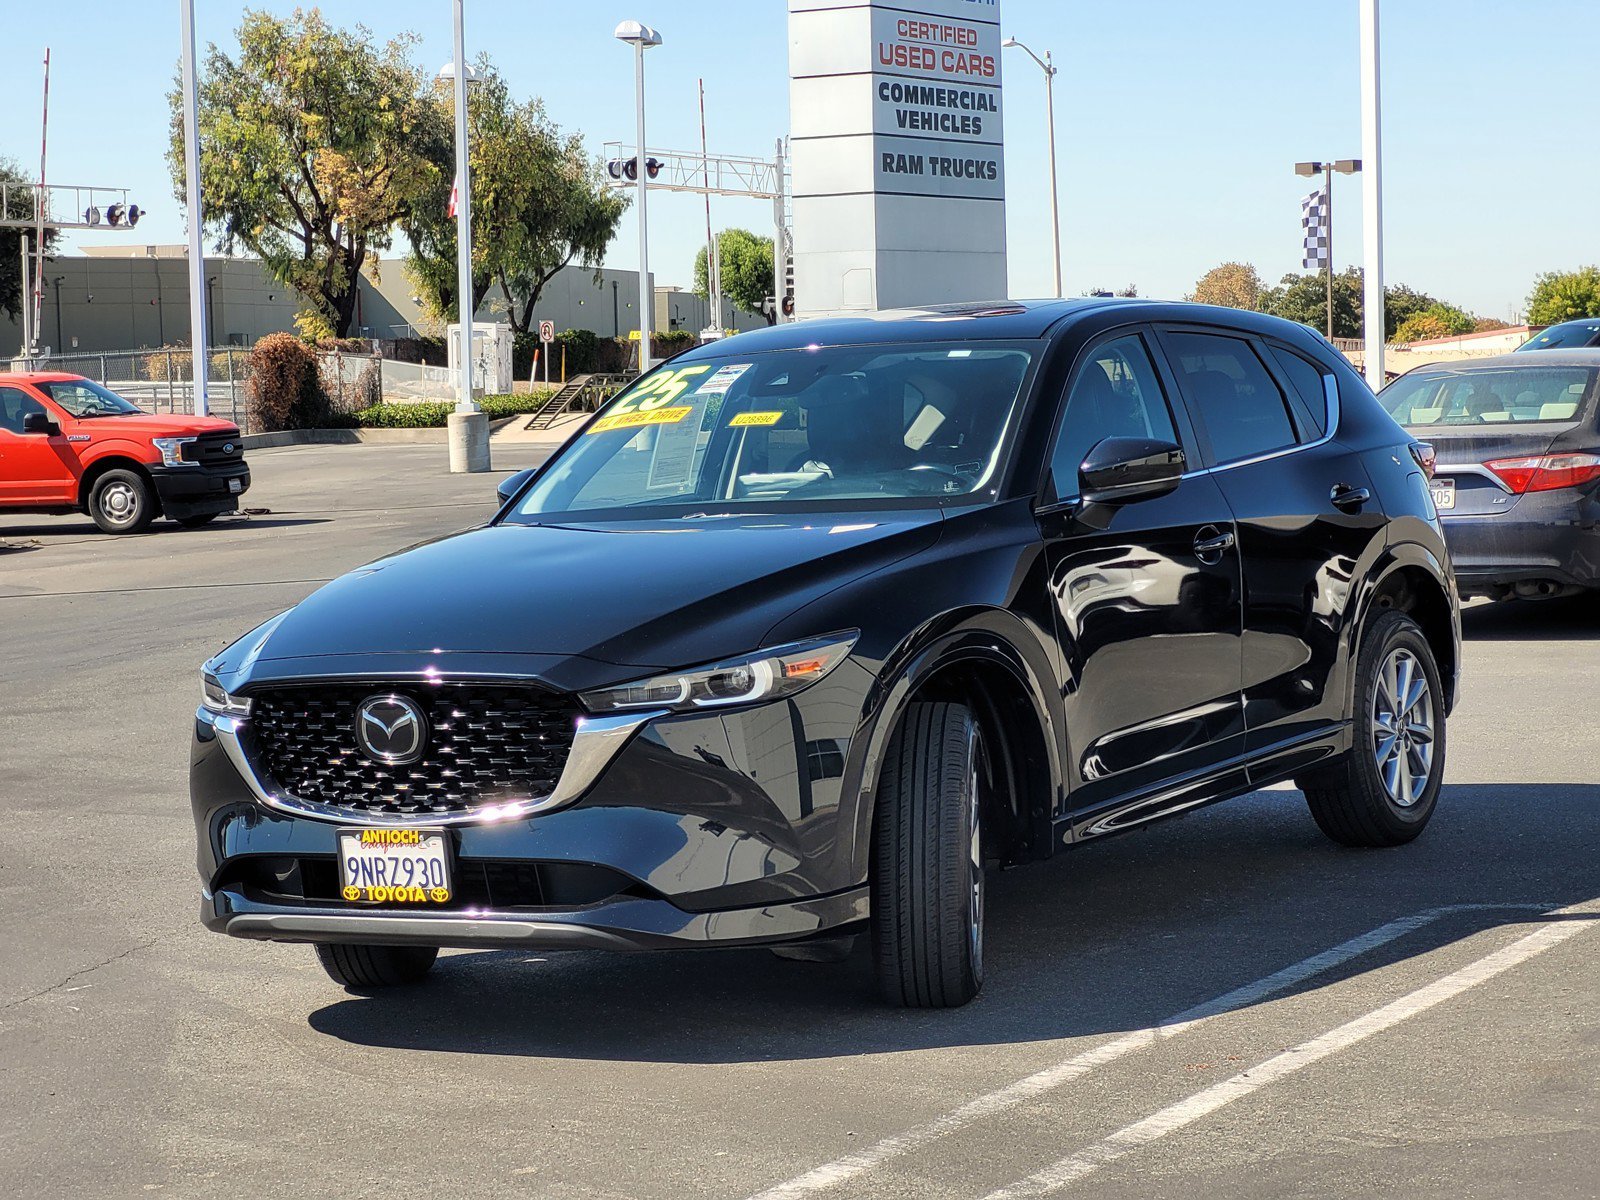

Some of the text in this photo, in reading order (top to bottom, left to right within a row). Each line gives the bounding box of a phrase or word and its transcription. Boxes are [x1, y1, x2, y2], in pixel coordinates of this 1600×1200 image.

[897, 19, 977, 46] CERTIFIED
[879, 43, 995, 77] USED CARS
[878, 82, 997, 112] COMMERCIAL
[896, 109, 982, 135] VEHICLES
[882, 153, 997, 180] RAM TRUCKS
[601, 365, 711, 418] 25
[649, 409, 687, 420] DRIVE
[361, 829, 419, 844] ANTIOCH
[347, 856, 444, 889] 9NRZ930
[366, 885, 427, 902] TOYOTA
